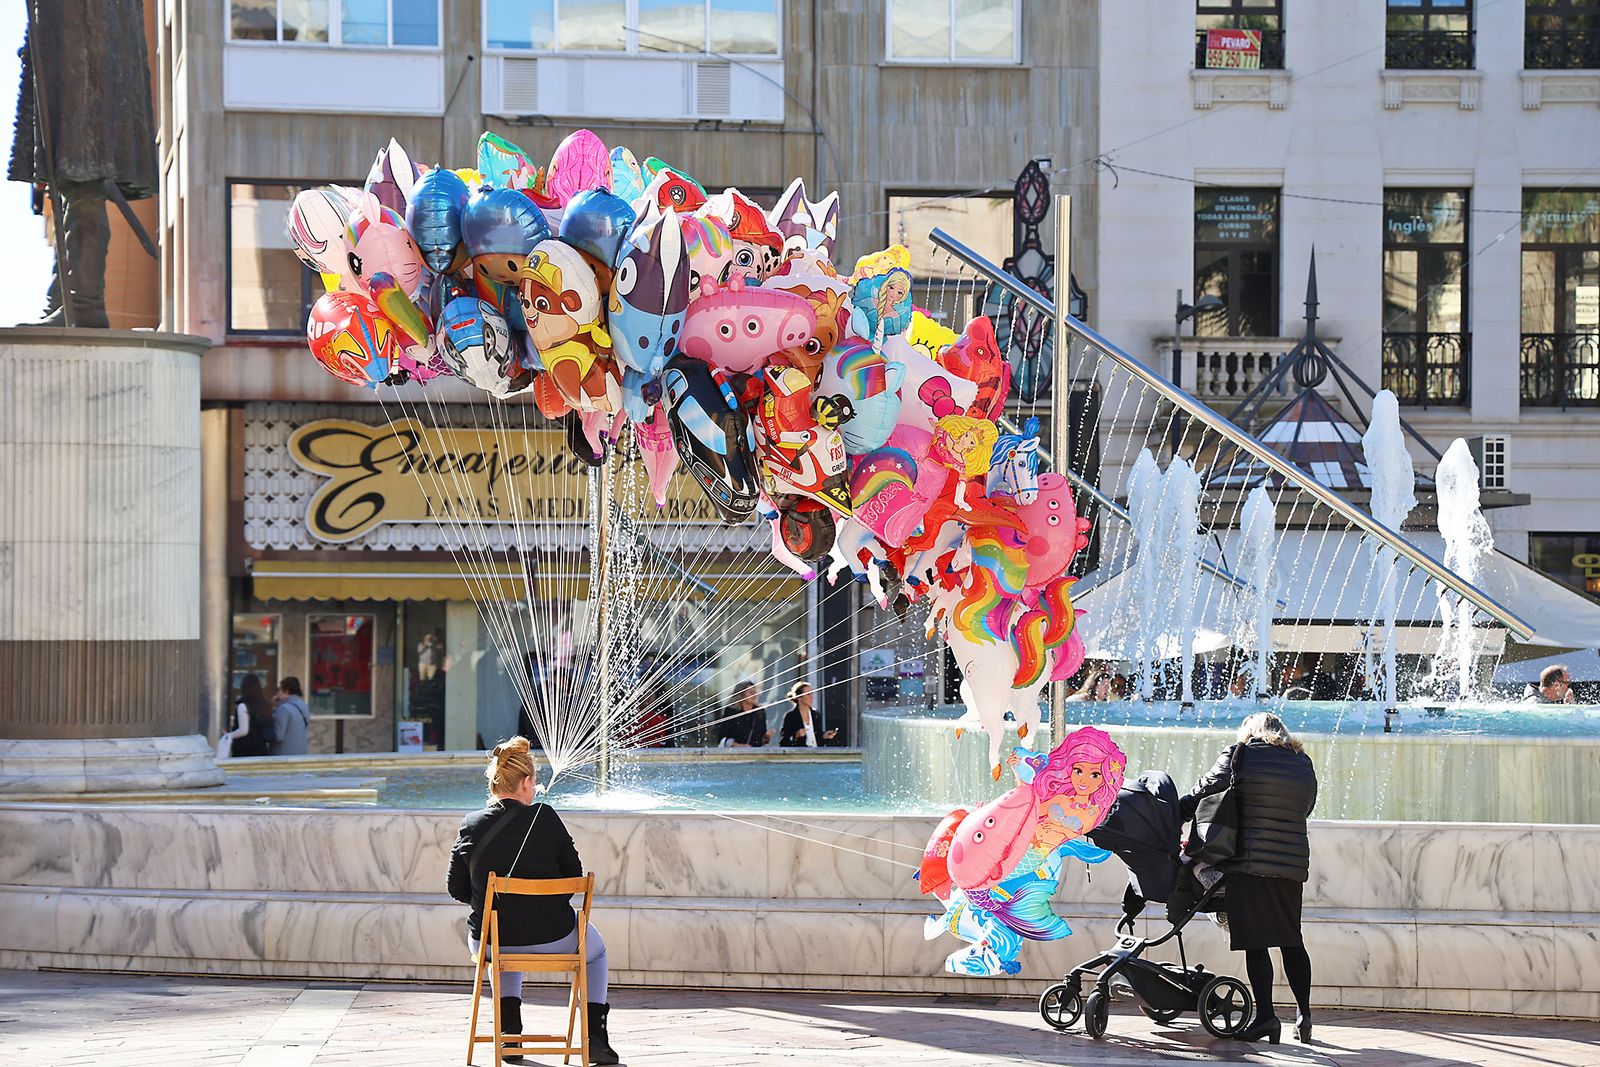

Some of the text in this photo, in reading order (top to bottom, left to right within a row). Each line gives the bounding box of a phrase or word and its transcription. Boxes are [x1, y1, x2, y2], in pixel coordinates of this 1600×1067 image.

[1207, 49, 1259, 68] 959 250 777
[767, 420, 778, 440] GRABO
[830, 487, 847, 501] 46
[426, 496, 499, 517] LANAS
[525, 497, 592, 518] MEDI
